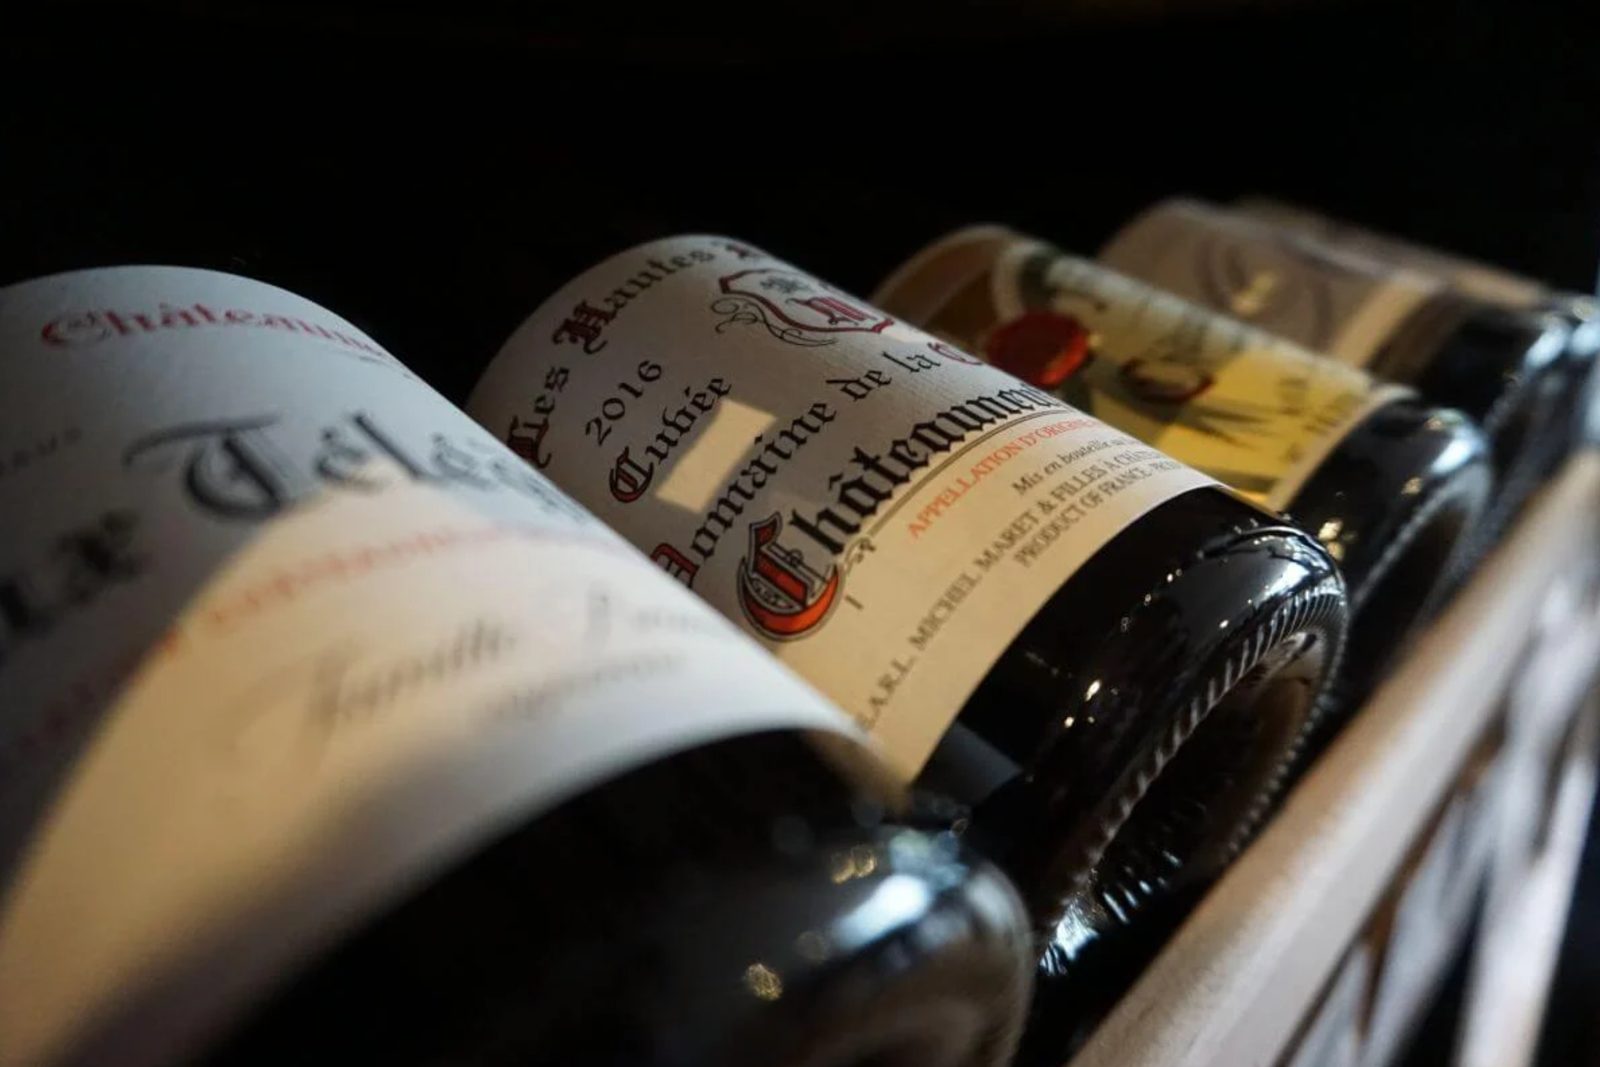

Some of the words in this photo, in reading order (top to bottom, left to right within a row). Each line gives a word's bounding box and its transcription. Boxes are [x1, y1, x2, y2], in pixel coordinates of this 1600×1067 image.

[552, 250, 715, 355] Hautes
[586, 360, 662, 447] 2016
[825, 368, 893, 402] de
[882, 350, 942, 374] la
[608, 377, 732, 503] Cuvée
[906, 439, 1025, 540] APPELLATION
[1011, 472, 1044, 496] Mis
[1043, 460, 1062, 476] en
[736, 382, 1066, 642] Châteauneu
[908, 571, 983, 651] MICHEL
[972, 510, 1040, 573] MARET
[1037, 499, 1057, 516] &
[1051, 463, 1108, 502] FILLES
[1013, 504, 1086, 568] PRODUCT
[1080, 492, 1104, 509] OF
[1099, 465, 1153, 498] FRANCE
